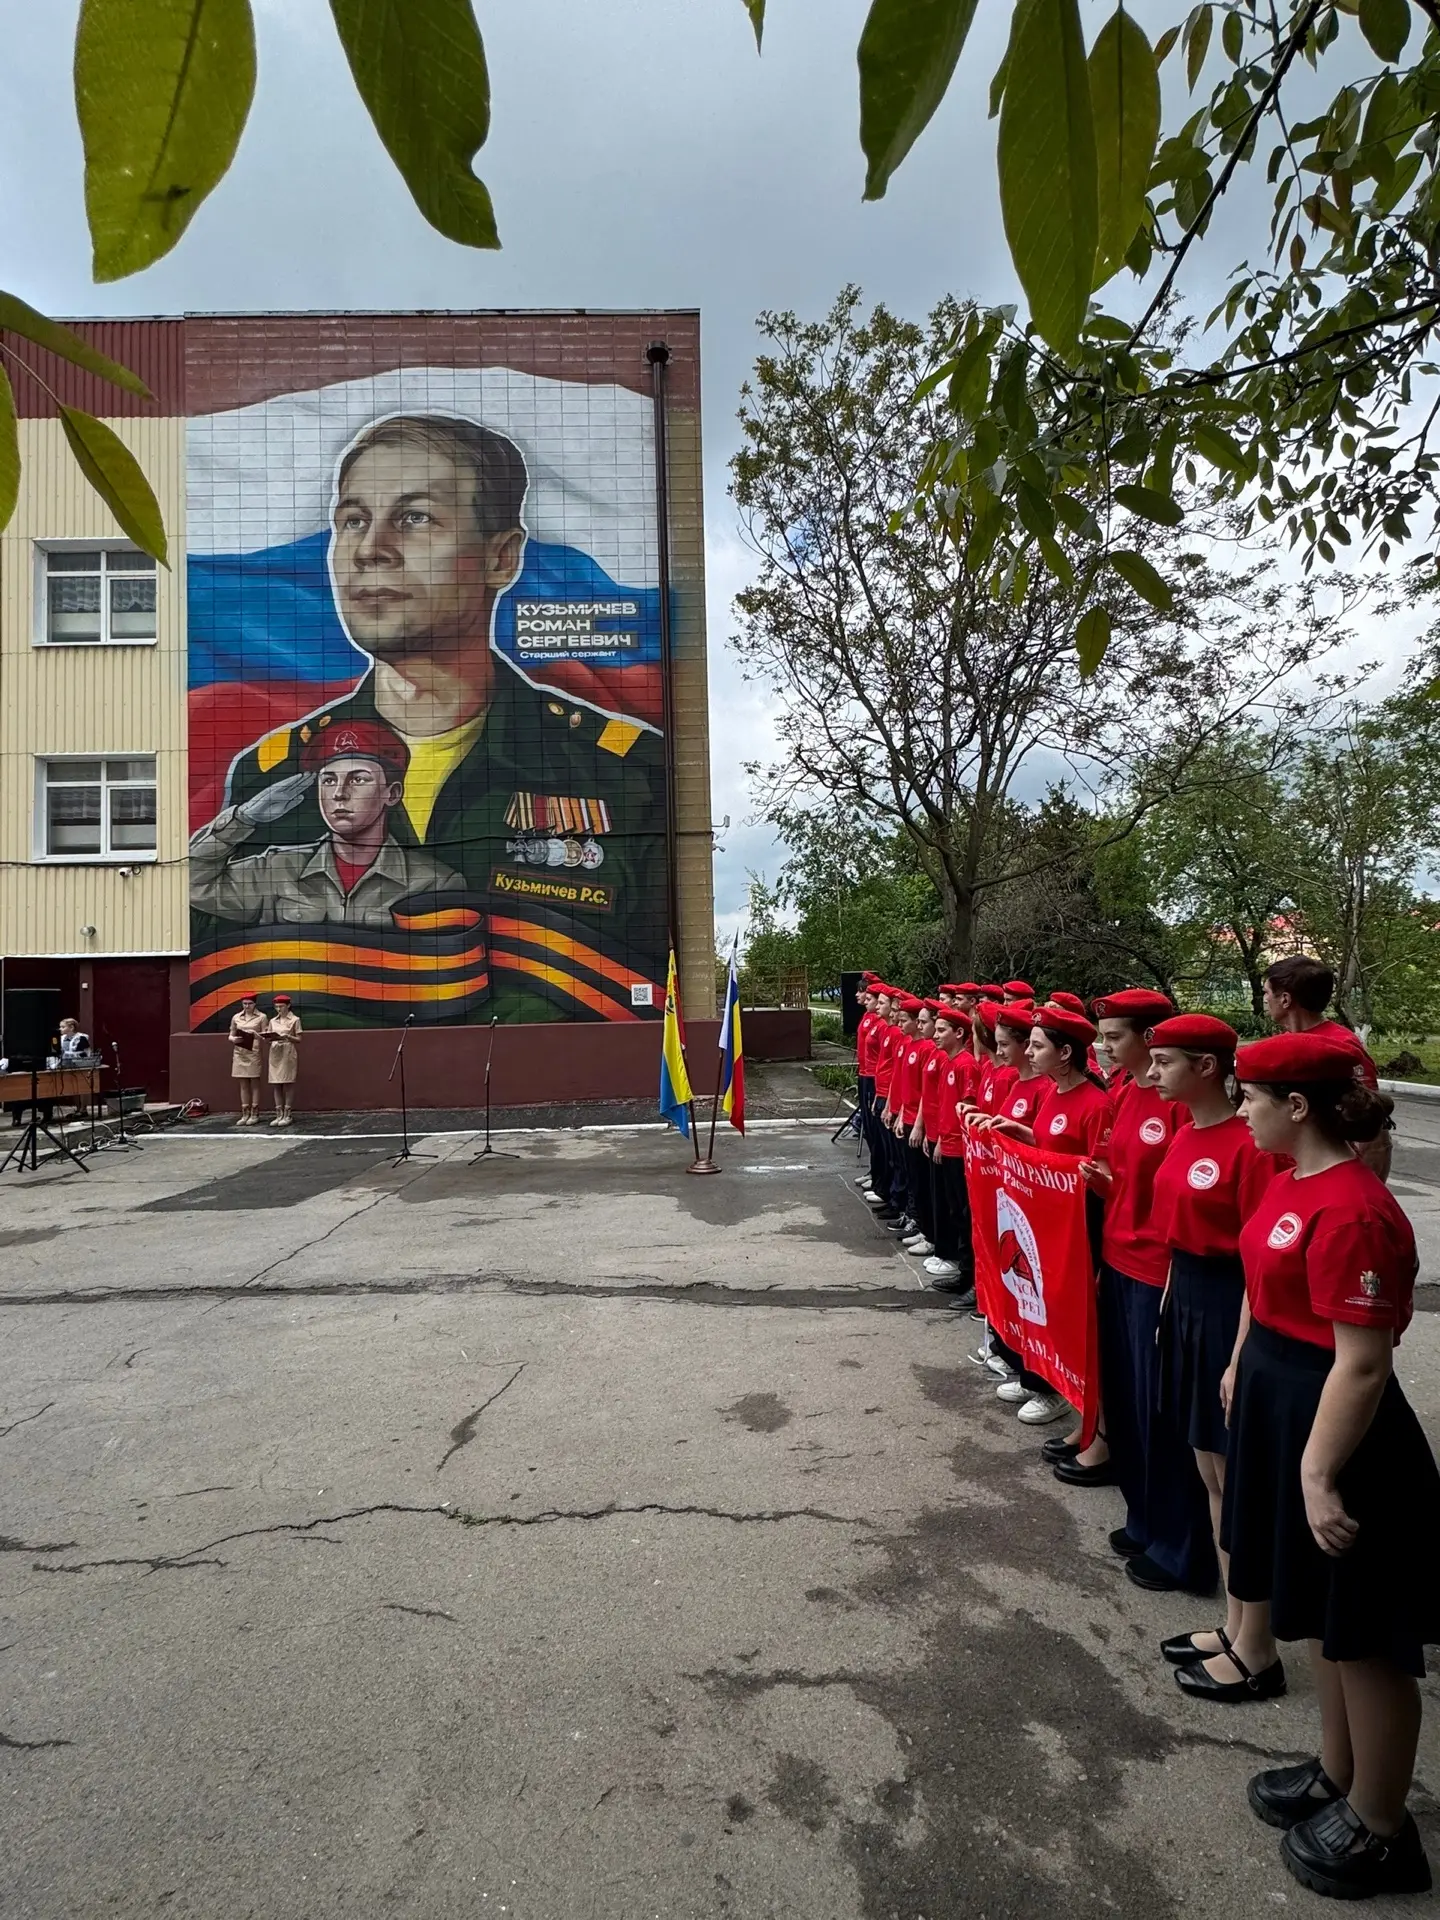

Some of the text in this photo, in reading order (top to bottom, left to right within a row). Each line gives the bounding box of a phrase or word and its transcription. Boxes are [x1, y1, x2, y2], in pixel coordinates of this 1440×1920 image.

[517, 602, 637, 616] КУЗЬМИЧЕВ
[517, 619, 591, 632] РОМАН
[517, 634, 631, 648] СЕРГЕЕВИЧ
[519, 650, 617, 660] Старший сержант
[495, 873, 609, 905] Кузьмичев Р.С.
[1024, 1162, 1078, 1194] РАЙОН
